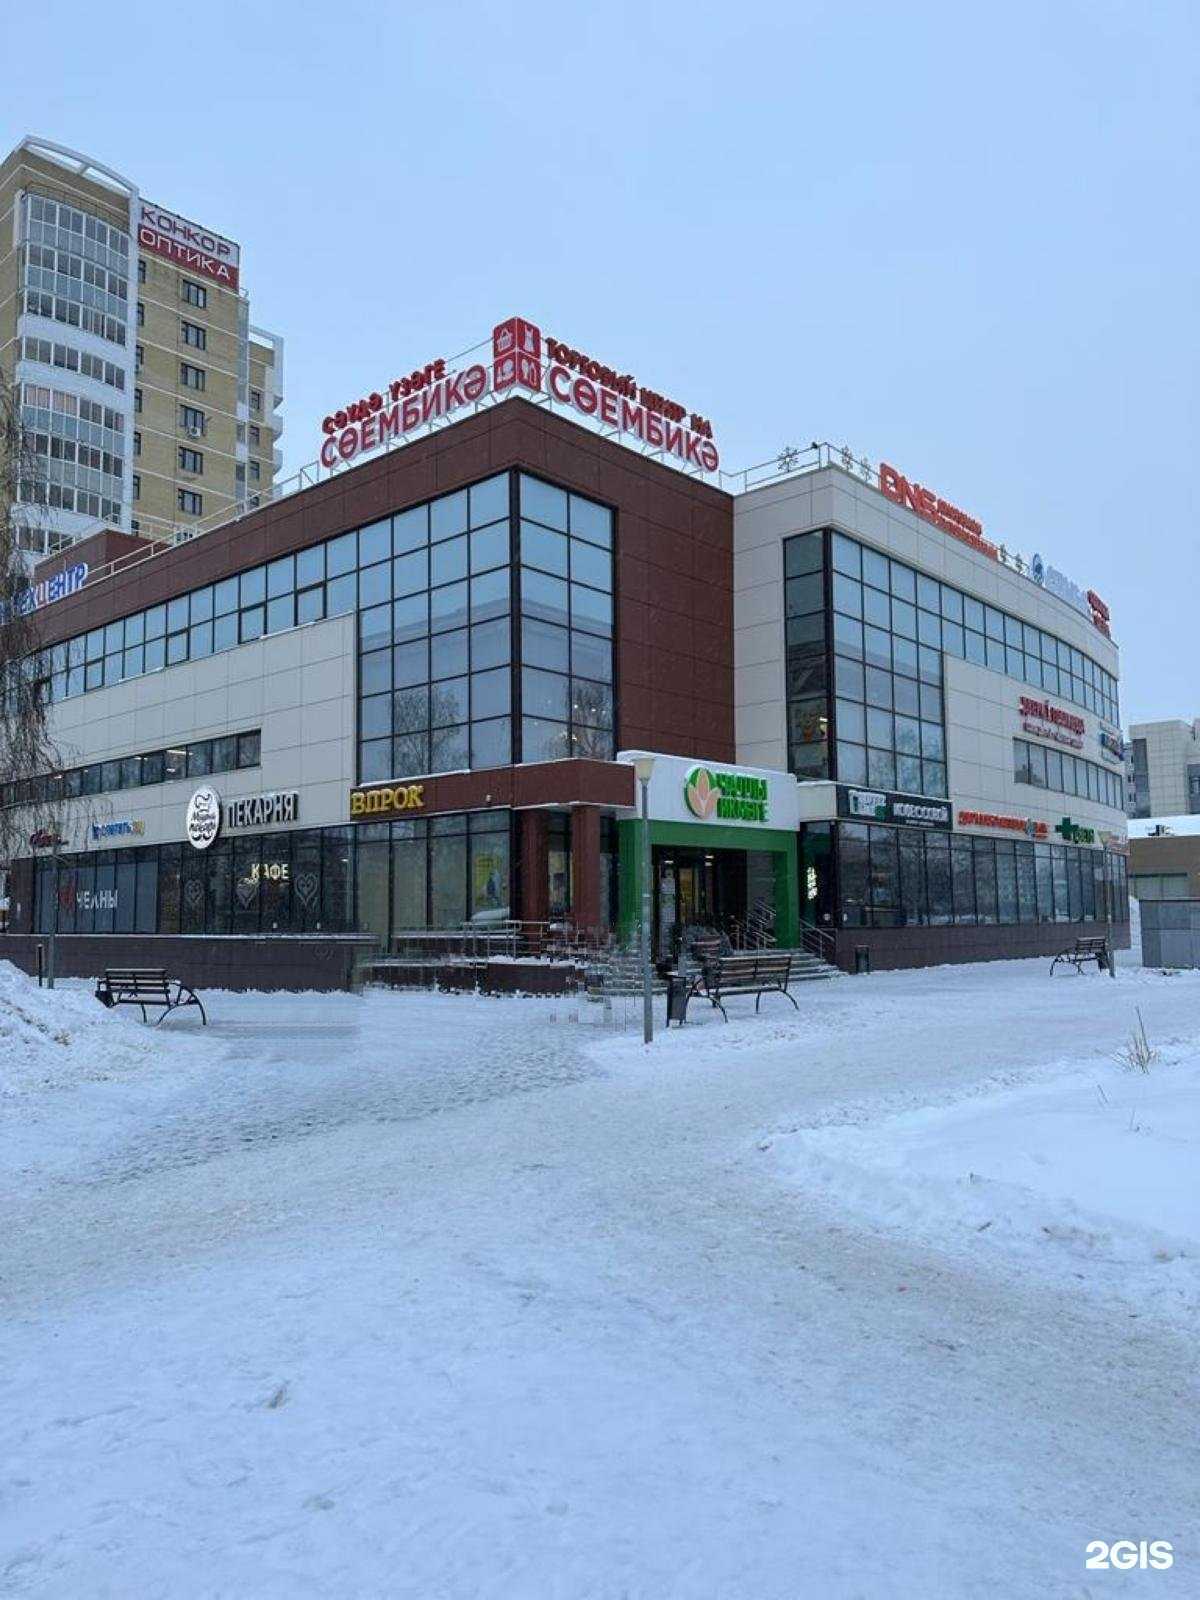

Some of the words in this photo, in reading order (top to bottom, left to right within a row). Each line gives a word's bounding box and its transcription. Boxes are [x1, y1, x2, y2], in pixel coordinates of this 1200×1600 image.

[140, 228, 231, 280] ОПТИКА
[141, 205, 231, 256] КОНКОР
[320, 364, 488, 469] СӨЕМБИКӘ
[548, 364, 720, 473] СӨЕМБИКӘ
[226, 791, 299, 829] ПЕКАРНЯ
[351, 785, 425, 815] ВПРОК
